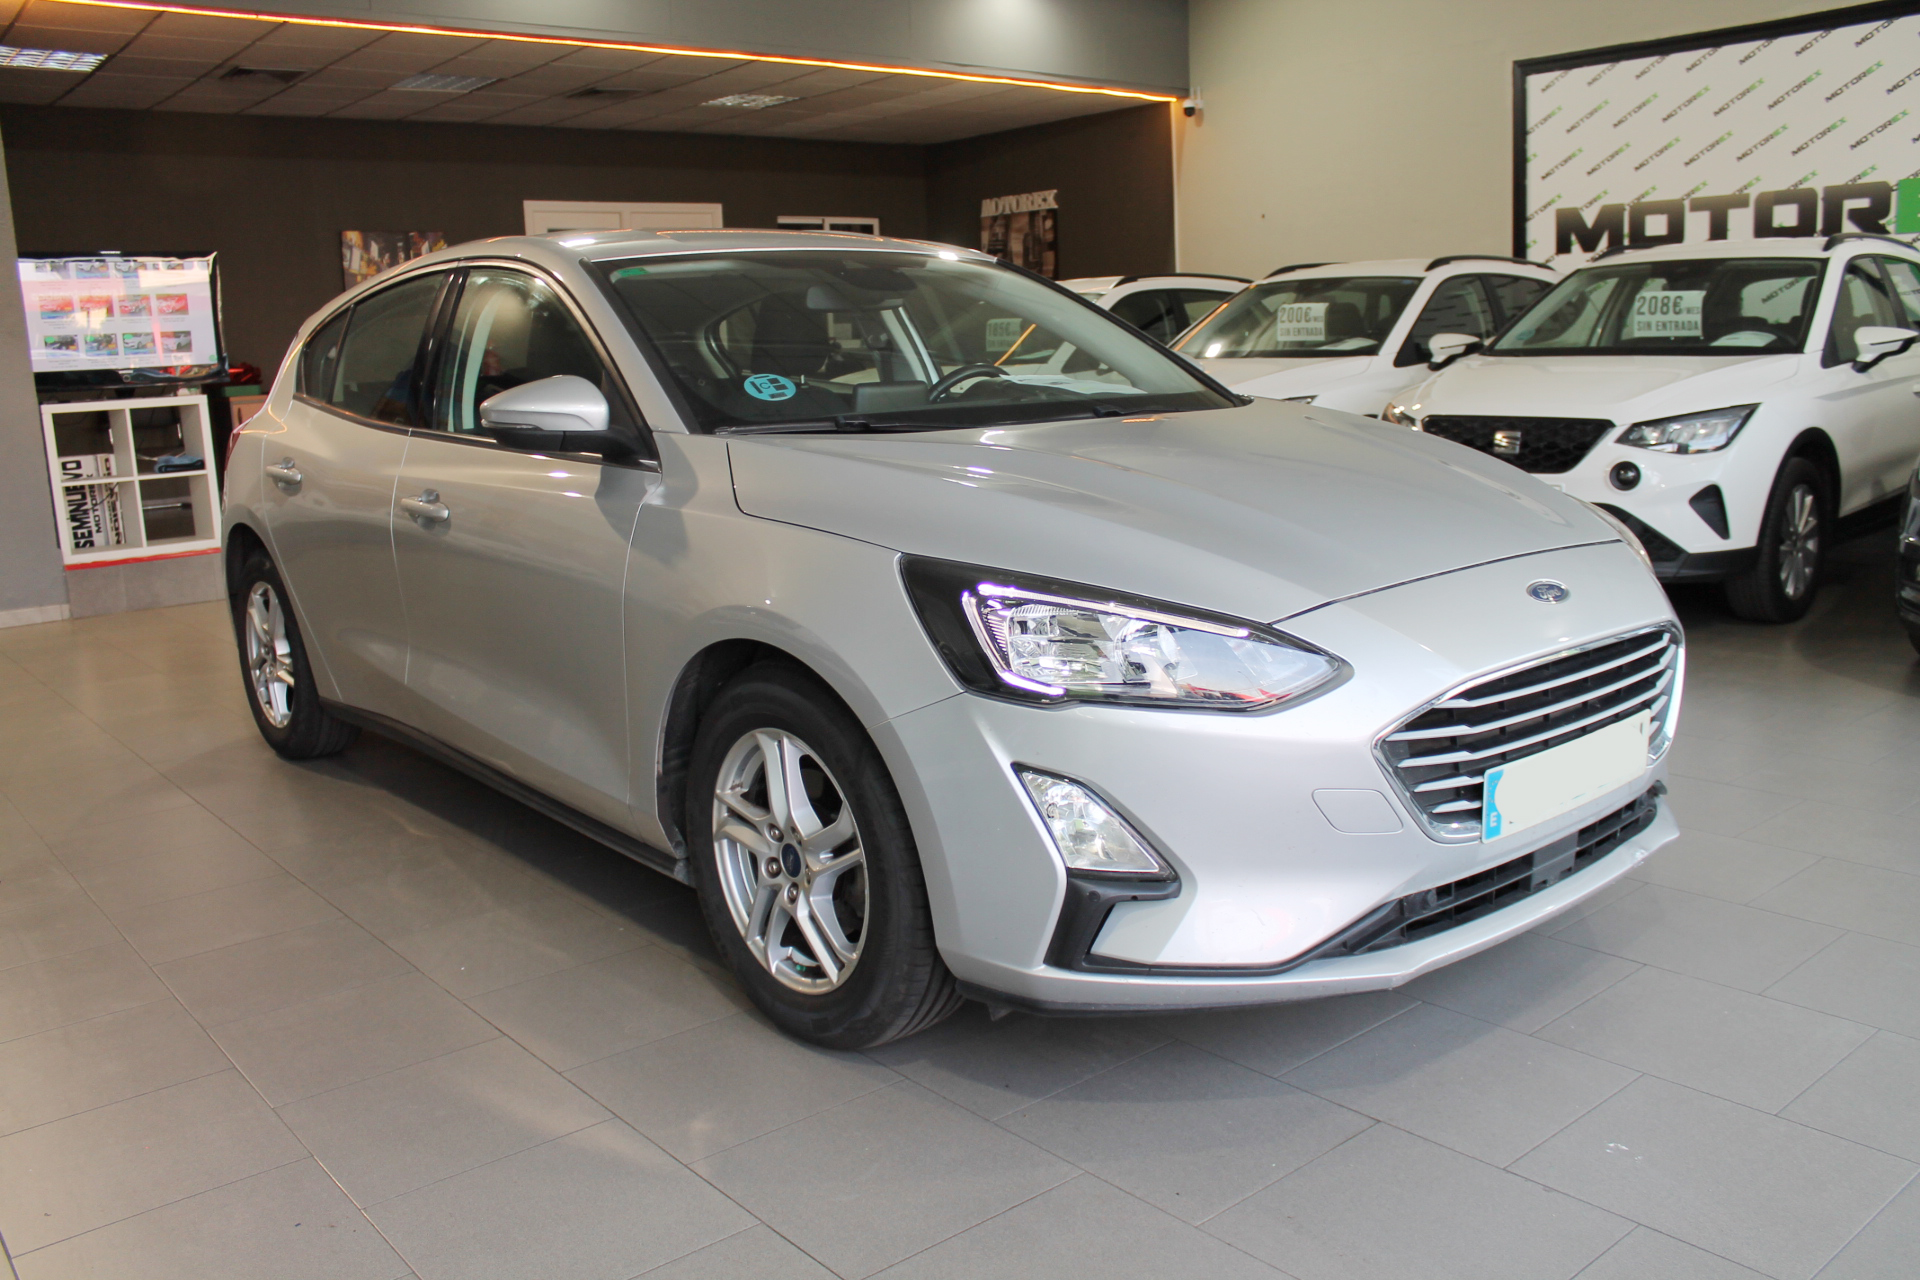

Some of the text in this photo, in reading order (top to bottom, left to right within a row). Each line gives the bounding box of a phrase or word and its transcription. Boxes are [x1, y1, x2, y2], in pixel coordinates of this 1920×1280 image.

[1795, 29, 1836, 56] MOTO
[1855, 18, 1898, 47] MOTO
[1635, 54, 1667, 79] MOTO
[1686, 46, 1721, 72] MOTO
[1739, 38, 1776, 65] MOTO
[1714, 78, 1763, 116] MOTOREX
[1768, 69, 1822, 110] MOTOREX
[1825, 60, 1885, 102] MOTOREX
[1613, 92, 1659, 128] MOTOREX
[1662, 85, 1710, 122] MOTOREX
[1736, 123, 1788, 162] MOTOREX
[1791, 116, 1847, 156] MOTOREX
[1849, 109, 1909, 150] MOTOREX
[1635, 136, 1681, 171] MOTOREX
[1684, 130, 1733, 167] MOTOREX
[1555, 180, 1920, 255] MOTOR
[1279, 306, 1312, 323] 200€
[1636, 295, 1683, 315] 208€
[1293, 327, 1324, 337] ENTRADA
[1637, 320, 1700, 332] SIN ENTRADA
[1536, 585, 1563, 600] Ford
[1489, 811, 1499, 829] E
